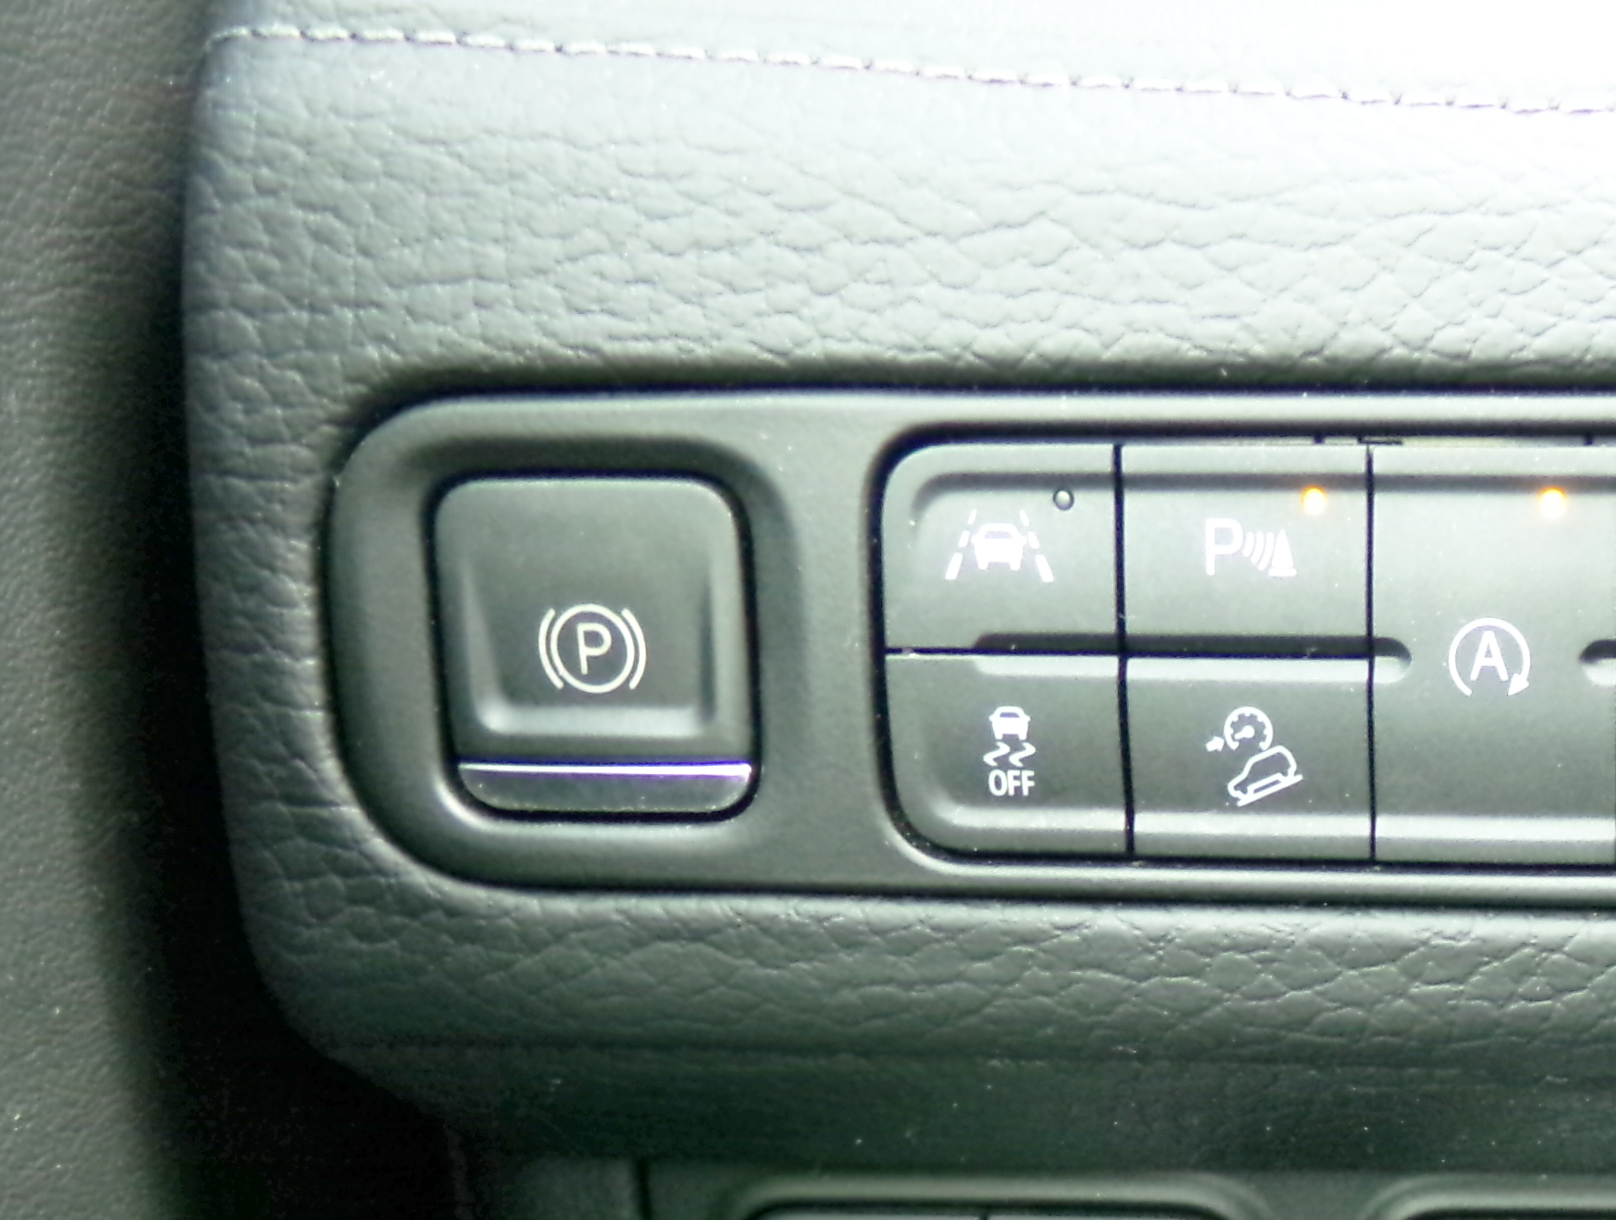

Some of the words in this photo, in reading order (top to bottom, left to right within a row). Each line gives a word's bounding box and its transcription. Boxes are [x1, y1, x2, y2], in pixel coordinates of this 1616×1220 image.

[1204, 518, 1244, 576] P
[575, 624, 612, 676] P
[1469, 630, 1510, 684] A
[988, 769, 1036, 798] OFF
